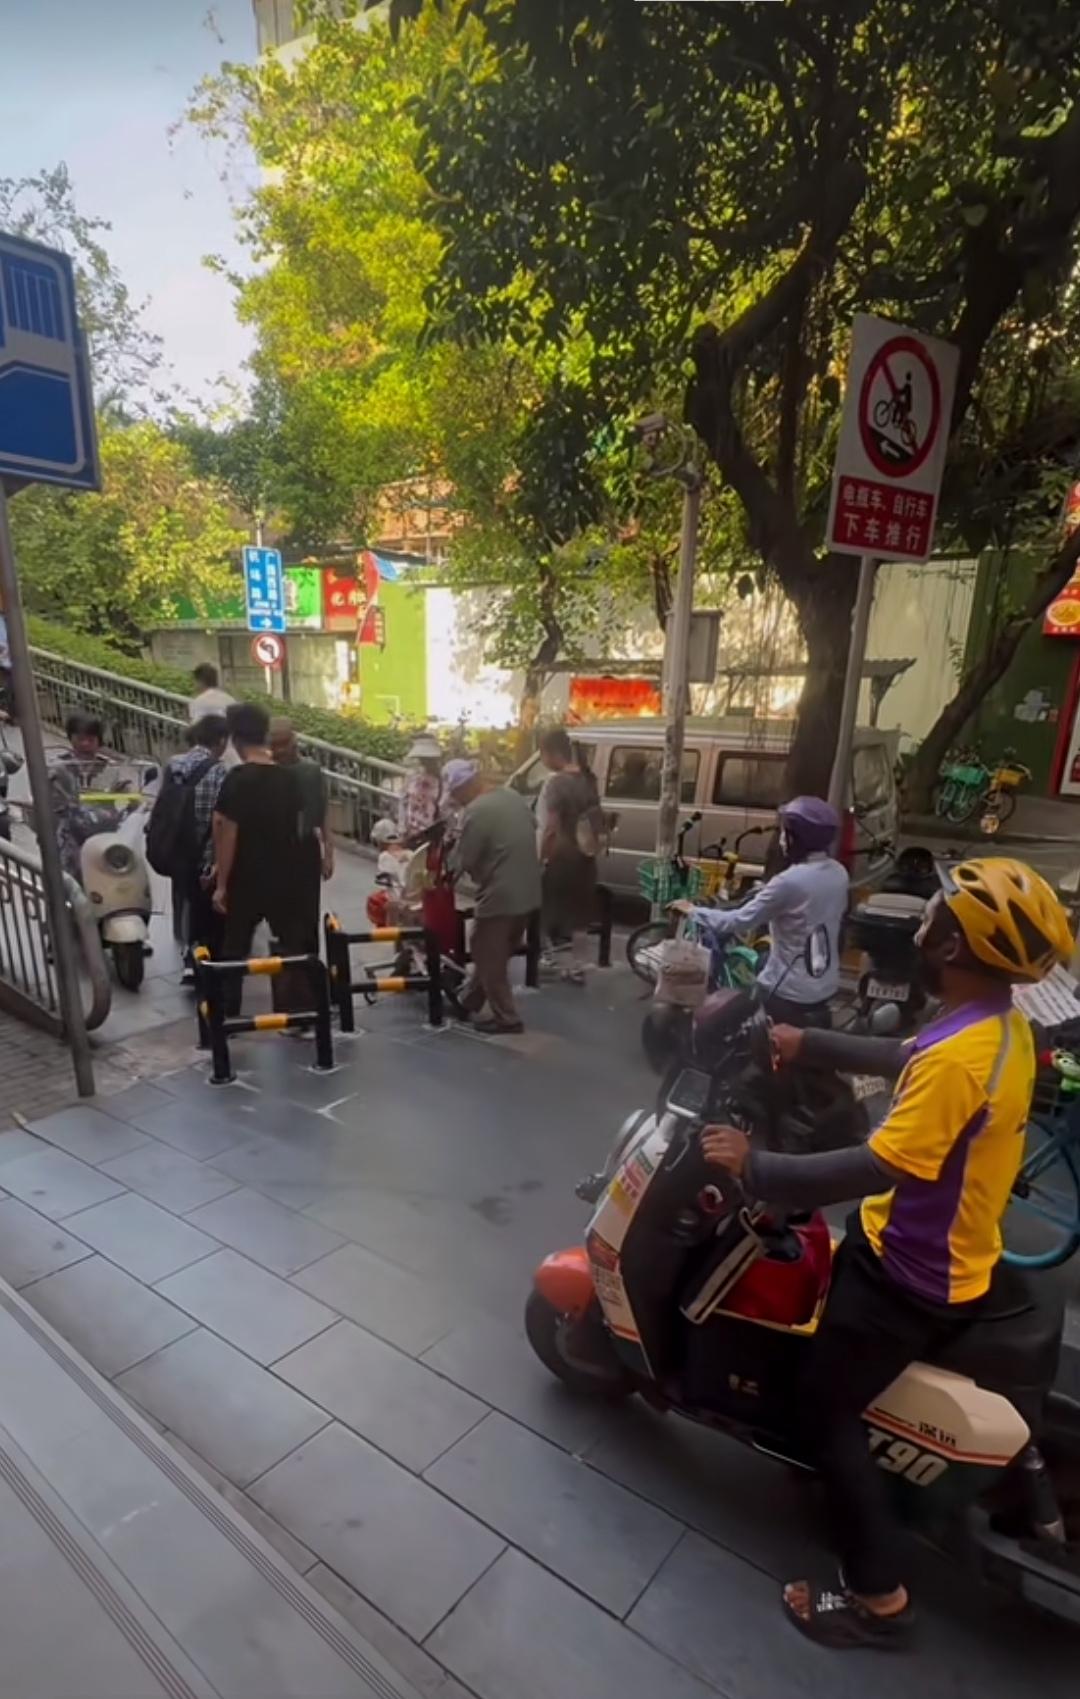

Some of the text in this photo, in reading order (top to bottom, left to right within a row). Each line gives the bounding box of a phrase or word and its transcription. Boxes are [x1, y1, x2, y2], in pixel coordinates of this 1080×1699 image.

[843, 512, 922, 551] 下车推行
[868, 1427, 949, 1486] T90
